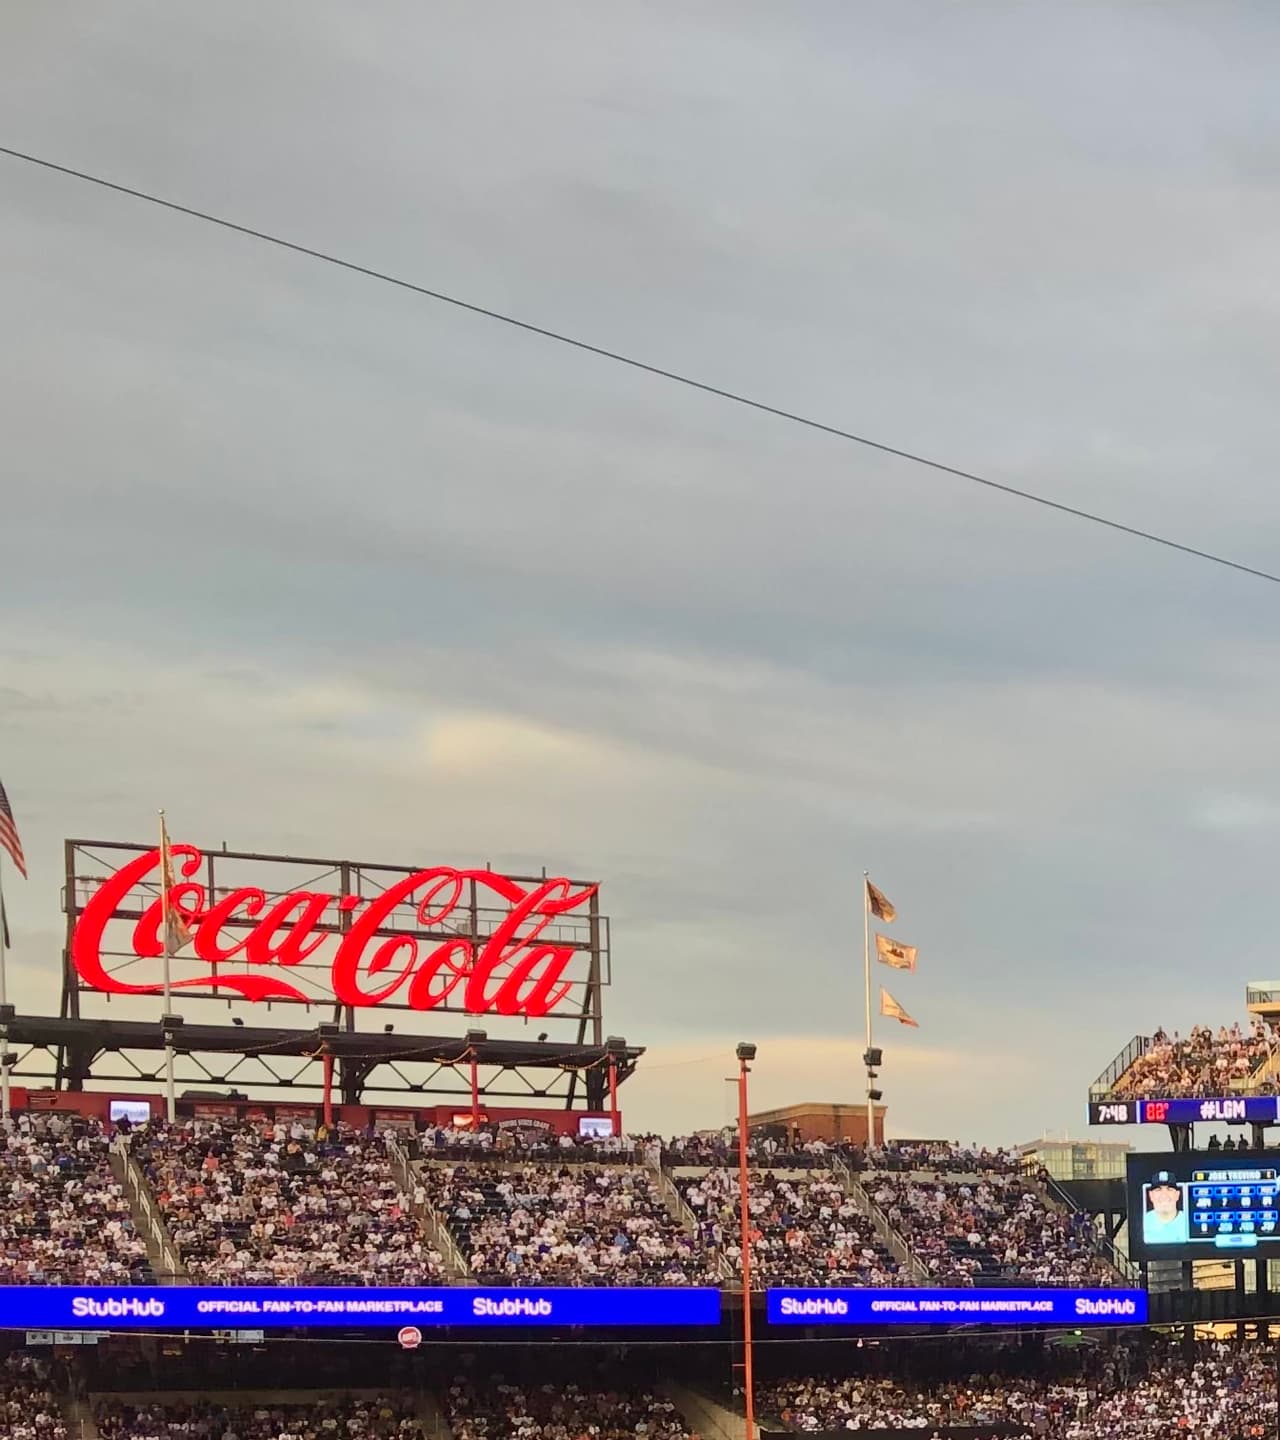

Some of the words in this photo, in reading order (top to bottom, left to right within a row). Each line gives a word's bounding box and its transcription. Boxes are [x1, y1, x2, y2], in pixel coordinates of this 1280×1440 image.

[72, 844, 600, 1016] Coca-Cola
[1098, 1105, 1128, 1123] 7:48
[1200, 1100, 1246, 1120] #LGM
[72, 1296, 165, 1317] StubHub
[197, 1301, 260, 1312] OFFICIAL
[262, 1301, 345, 1312] FAN-TO-FAN
[346, 1300, 443, 1312] MARKETPLACE
[473, 1297, 552, 1315] StubHub
[781, 1298, 848, 1315] StubHub
[871, 1301, 916, 1312] OFFICIAL
[918, 1301, 980, 1312] FAN-TO-FAN
[980, 1301, 1054, 1312] MARKETPLACE
[1075, 1298, 1136, 1315] StubHub
